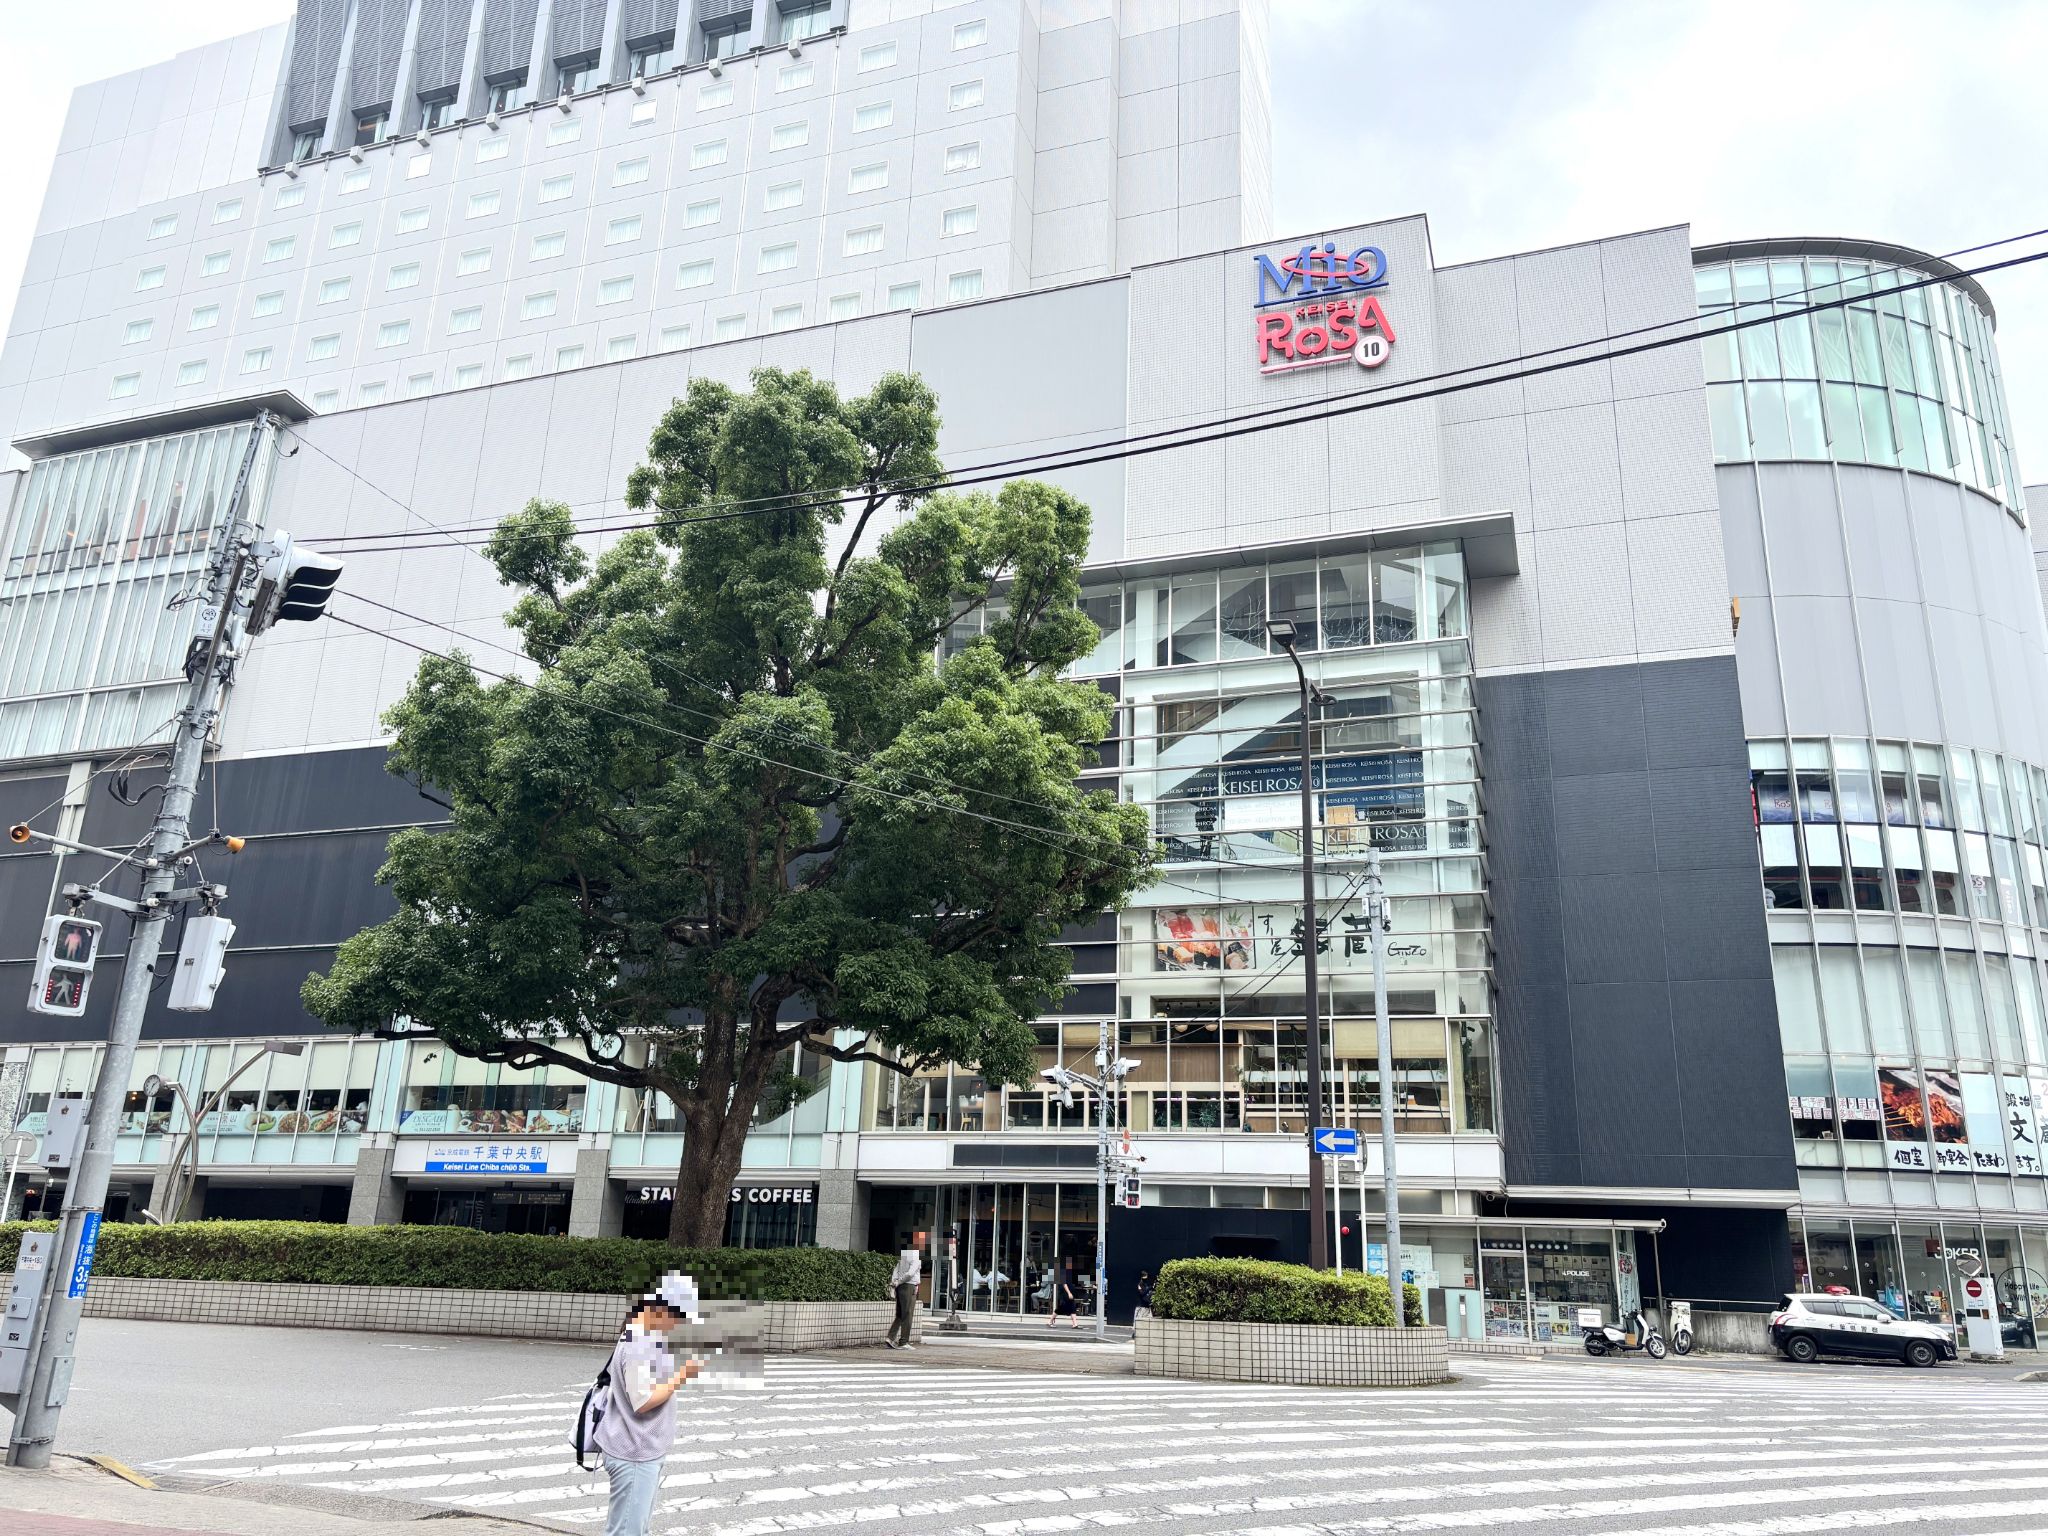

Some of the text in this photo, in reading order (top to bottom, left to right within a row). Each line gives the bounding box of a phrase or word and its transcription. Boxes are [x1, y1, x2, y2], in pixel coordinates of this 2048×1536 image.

[1295, 299, 1357, 318] KEISEI
[1362, 341, 1381, 358] 10
[1222, 779, 1262, 795] KEISEI
[1376, 825, 1419, 840] ROSA
[473, 1146, 543, 1160] 千葉中央駅
[443, 1163, 464, 1171] Keisei
[464, 1163, 479, 1171] Line
[480, 1163, 500, 1171] Chiba
[749, 1188, 813, 1203] COFFEE
[83, 1244, 93, 1266] 海抜
[75, 1266, 89, 1283] 3.5
